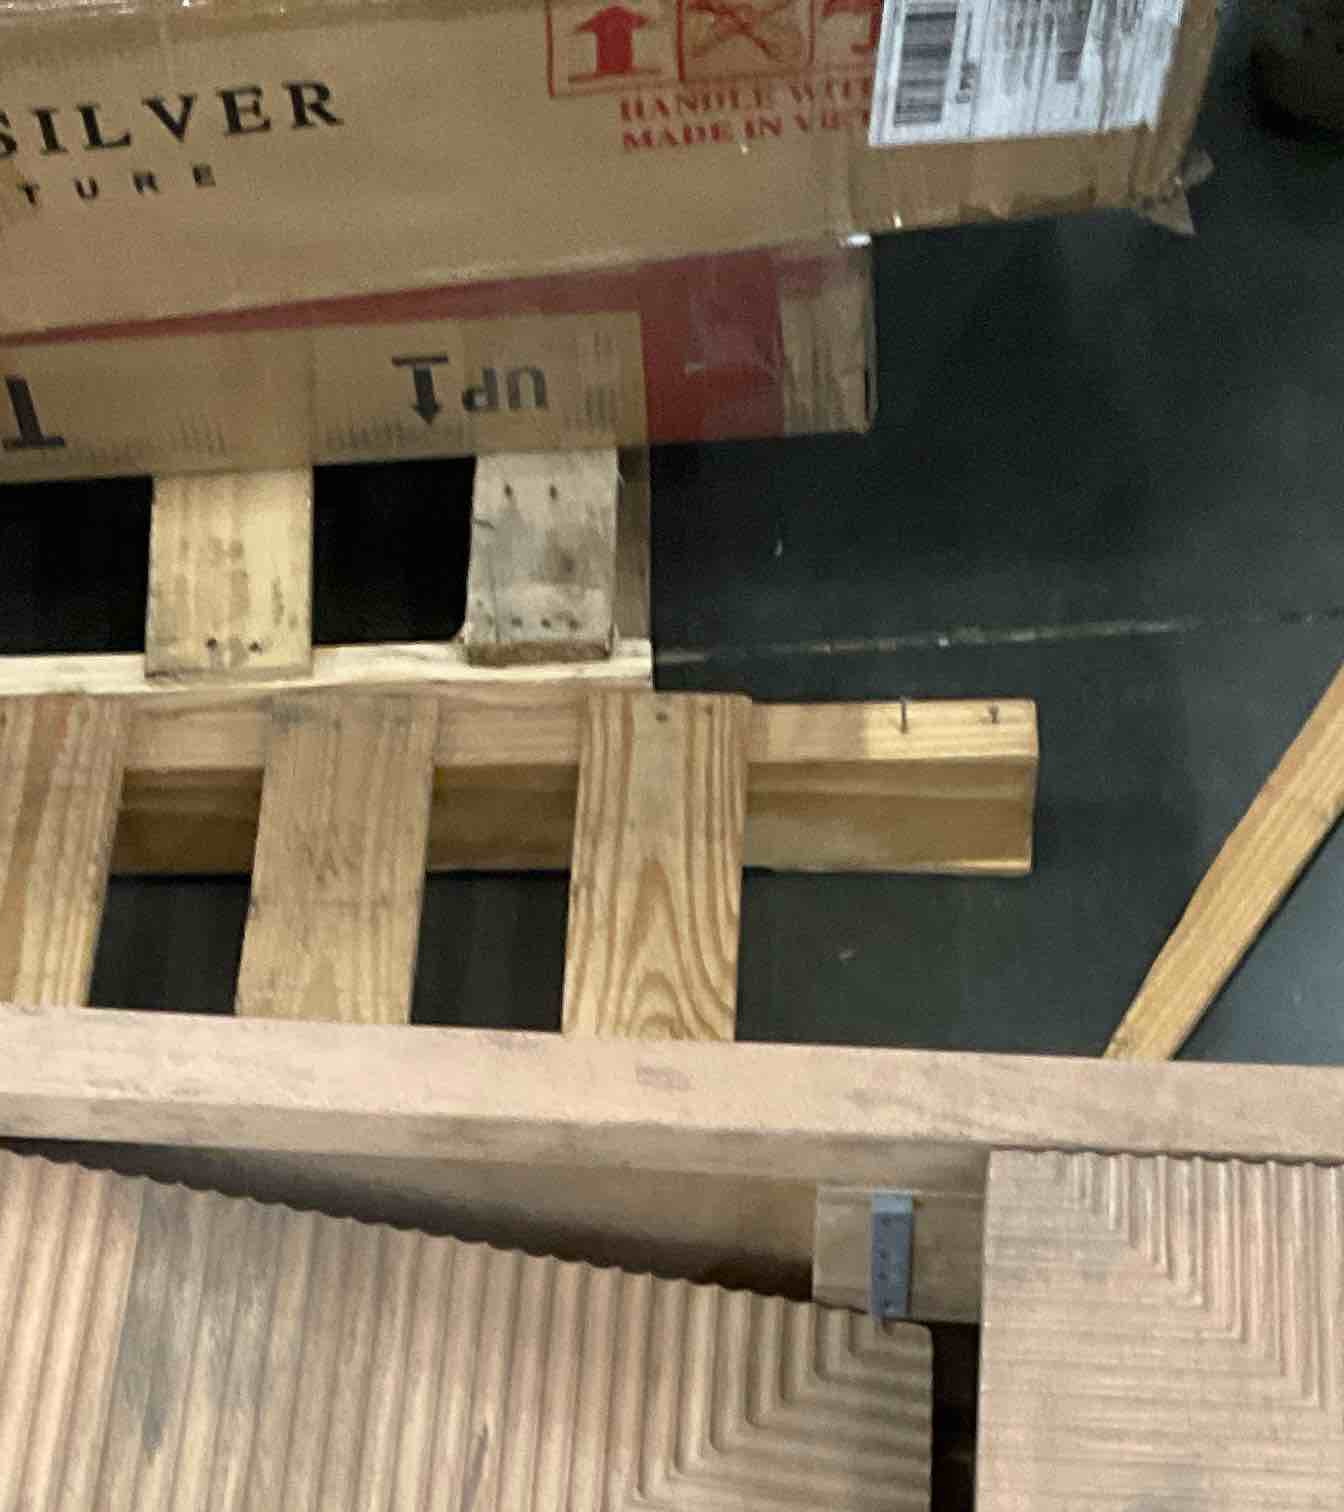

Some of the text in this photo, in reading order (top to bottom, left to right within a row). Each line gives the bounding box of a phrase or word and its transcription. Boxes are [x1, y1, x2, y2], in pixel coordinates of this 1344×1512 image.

[622, 123, 733, 148] MADE
[743, 115, 784, 140] IN
[461, 367, 548, 412] UP
